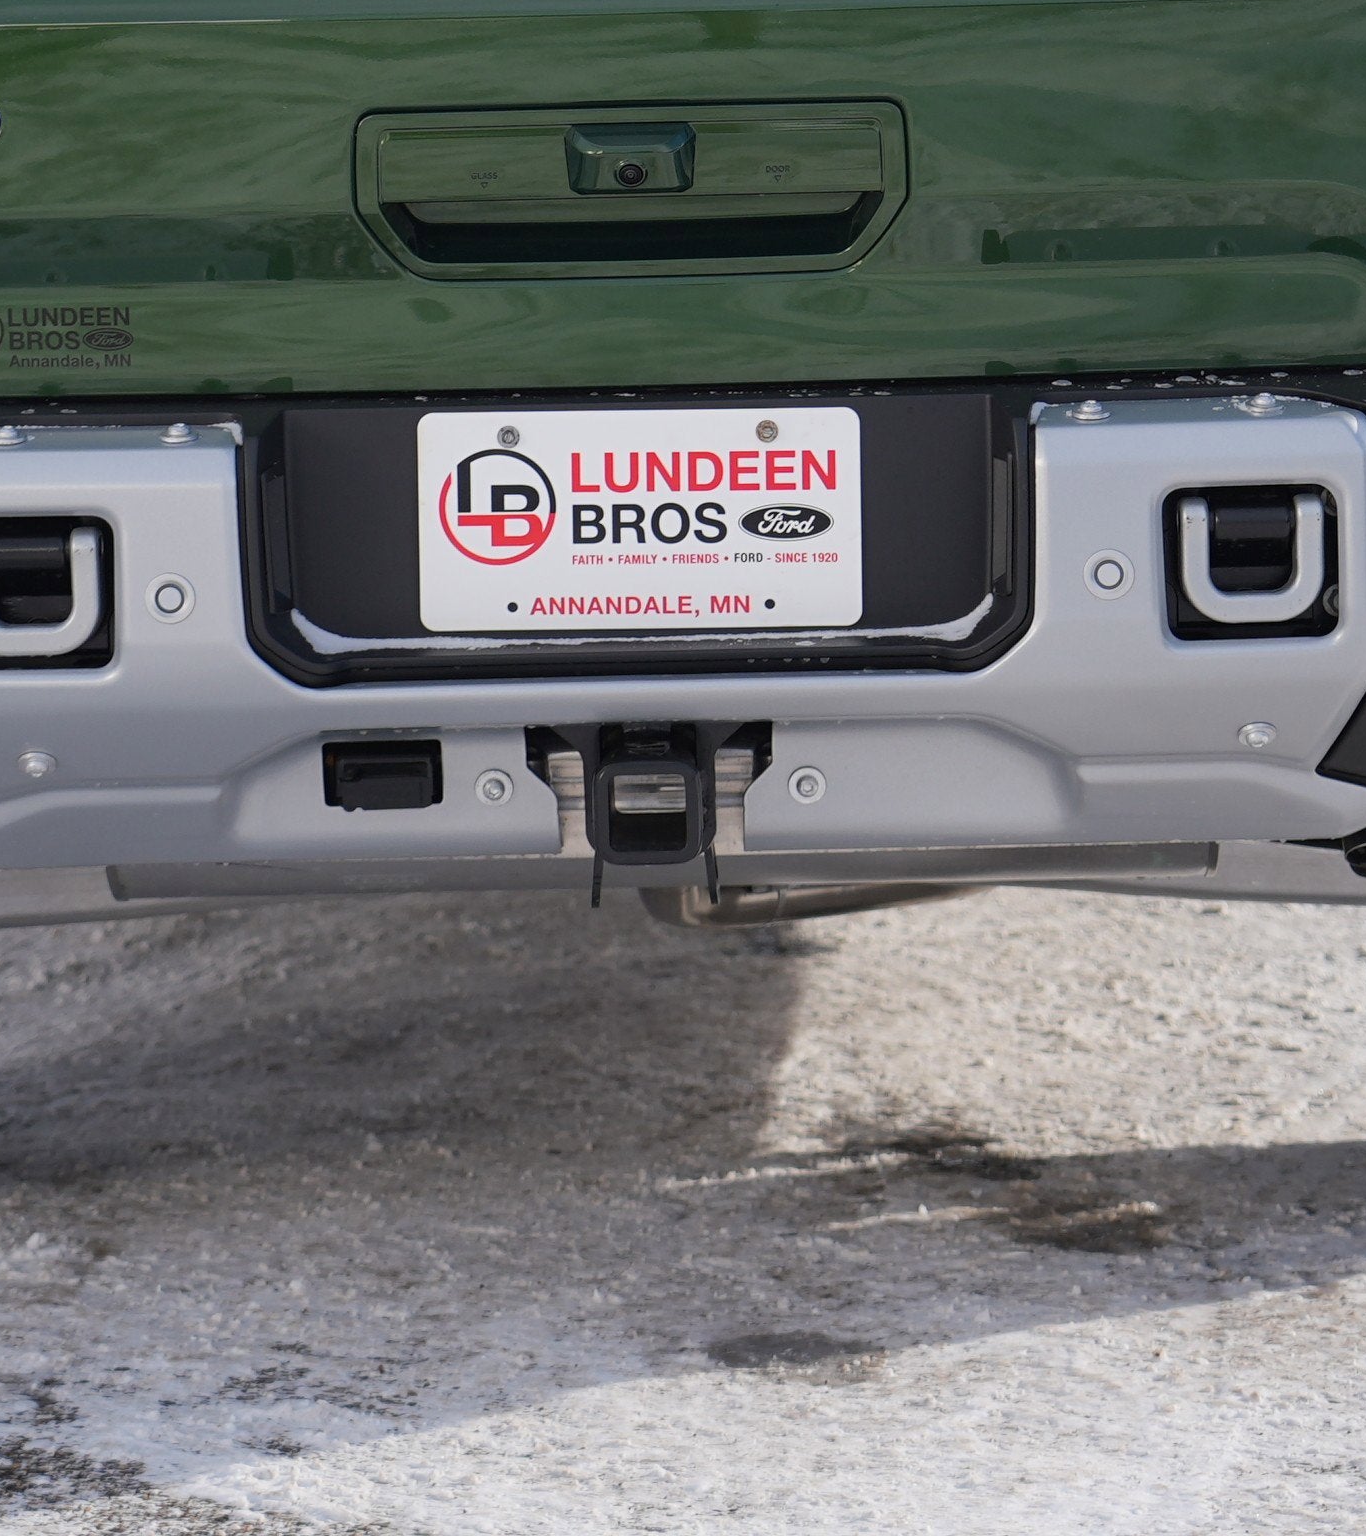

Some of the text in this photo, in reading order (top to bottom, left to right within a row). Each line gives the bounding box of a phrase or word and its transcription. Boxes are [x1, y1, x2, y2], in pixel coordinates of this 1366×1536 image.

[765, 164, 791, 173] DOOR
[7, 306, 131, 328] LUNDEEN
[8, 330, 81, 351] BROS
[8, 353, 132, 370] Annandale, MN
[570, 449, 837, 493] LUNDEEN
[571, 501, 818, 545] BROS Ford
[572, 554, 604, 565] FAITH
[618, 554, 658, 565] FAMILY
[672, 553, 720, 564] FRIENDS
[734, 552, 764, 563] FORD
[774, 552, 808, 563] SINCE
[812, 552, 839, 563] 1920
[529, 595, 751, 618] ANNANDALE, MN
